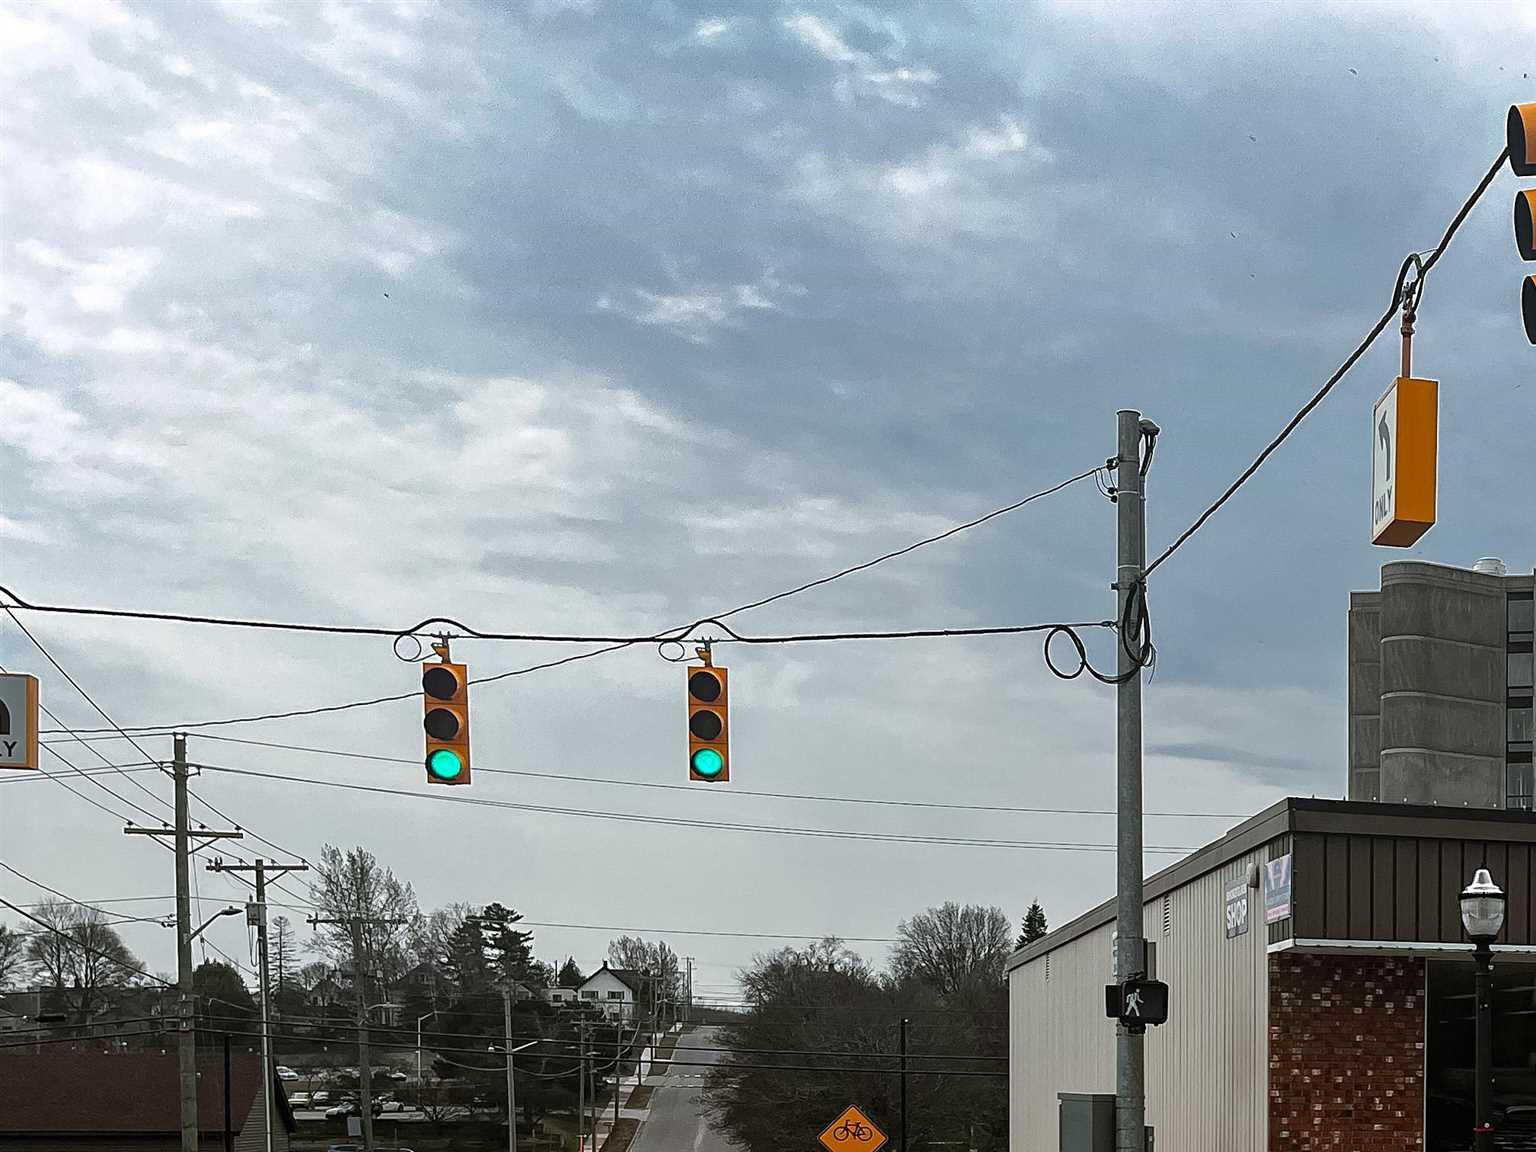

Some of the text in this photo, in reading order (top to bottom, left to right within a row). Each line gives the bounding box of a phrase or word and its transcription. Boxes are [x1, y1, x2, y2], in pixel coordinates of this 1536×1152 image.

[1375, 486, 1392, 525] ONLY
[0, 740, 17, 757] Y
[1226, 899, 1247, 930] SHOP
